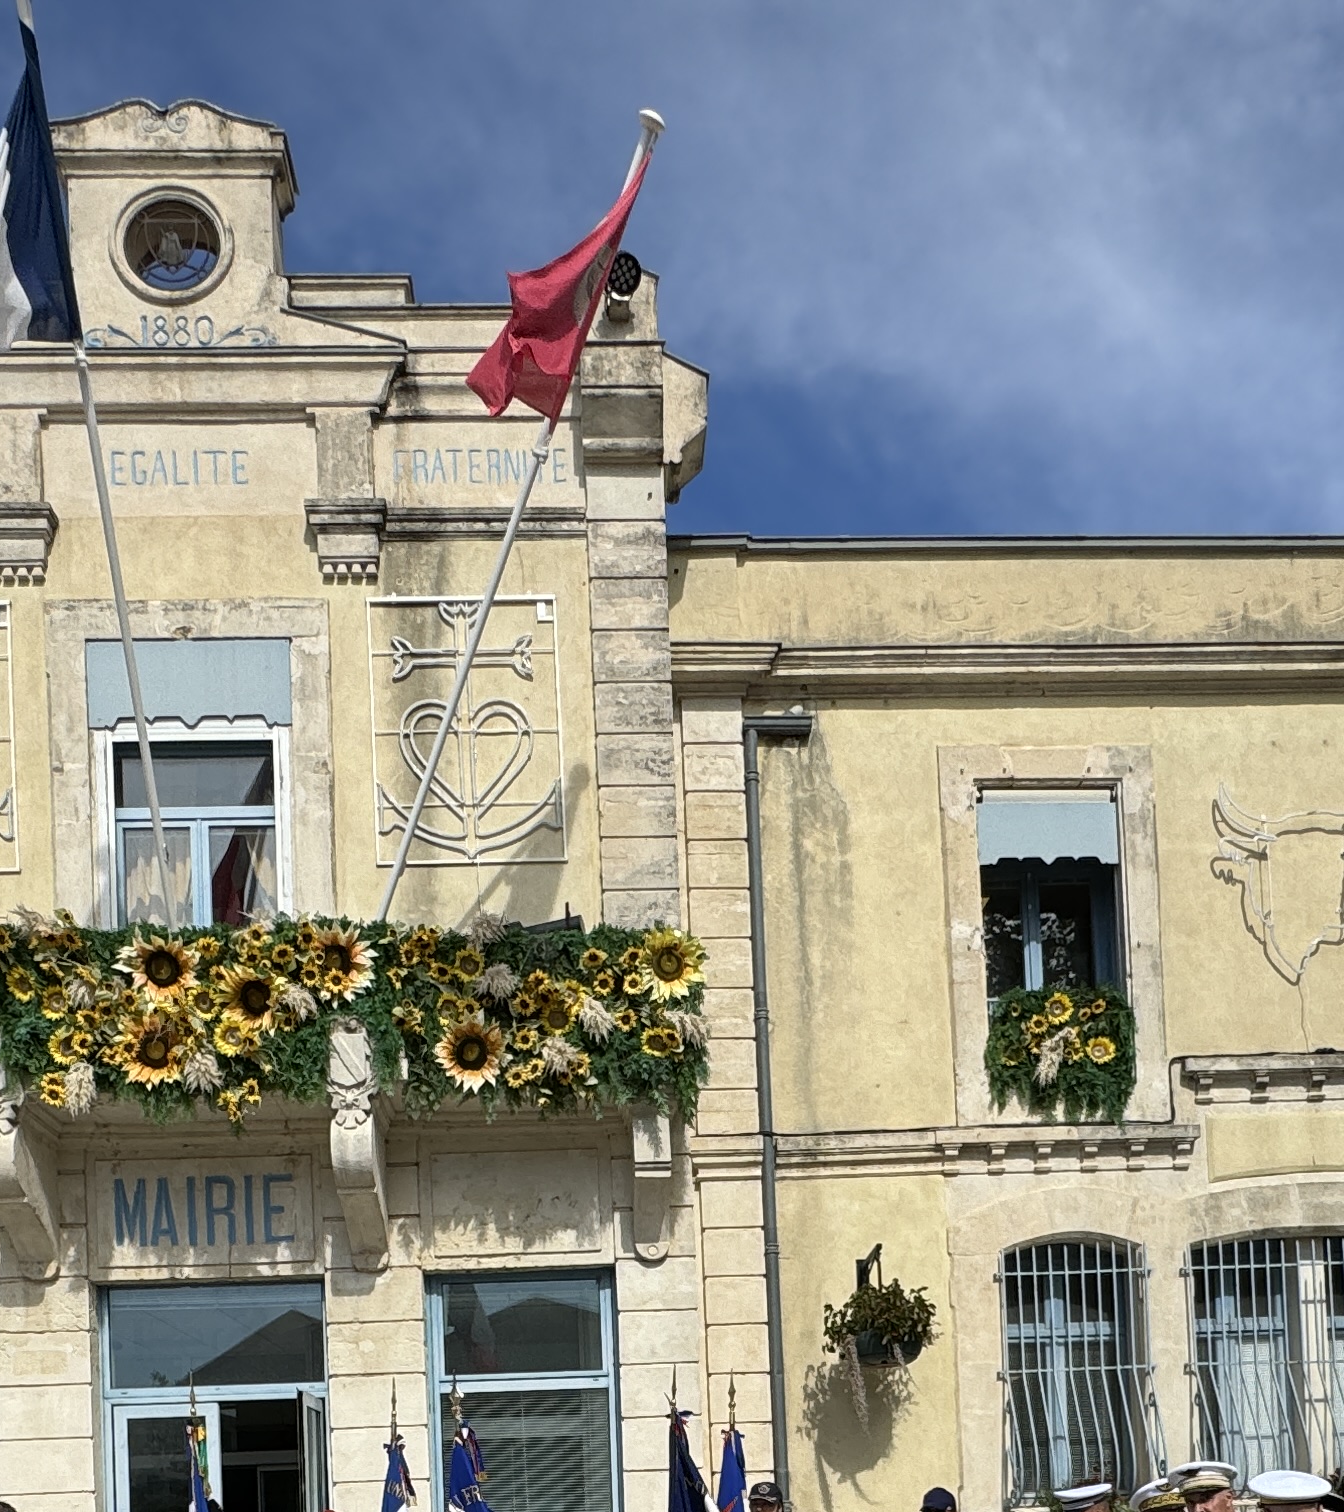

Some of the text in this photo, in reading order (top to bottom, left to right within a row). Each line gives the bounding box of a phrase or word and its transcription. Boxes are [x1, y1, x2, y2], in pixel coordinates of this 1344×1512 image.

[140, 315, 214, 346] 1880
[110, 449, 249, 486] EGALITE
[113, 1173, 295, 1247] MAIRIE
